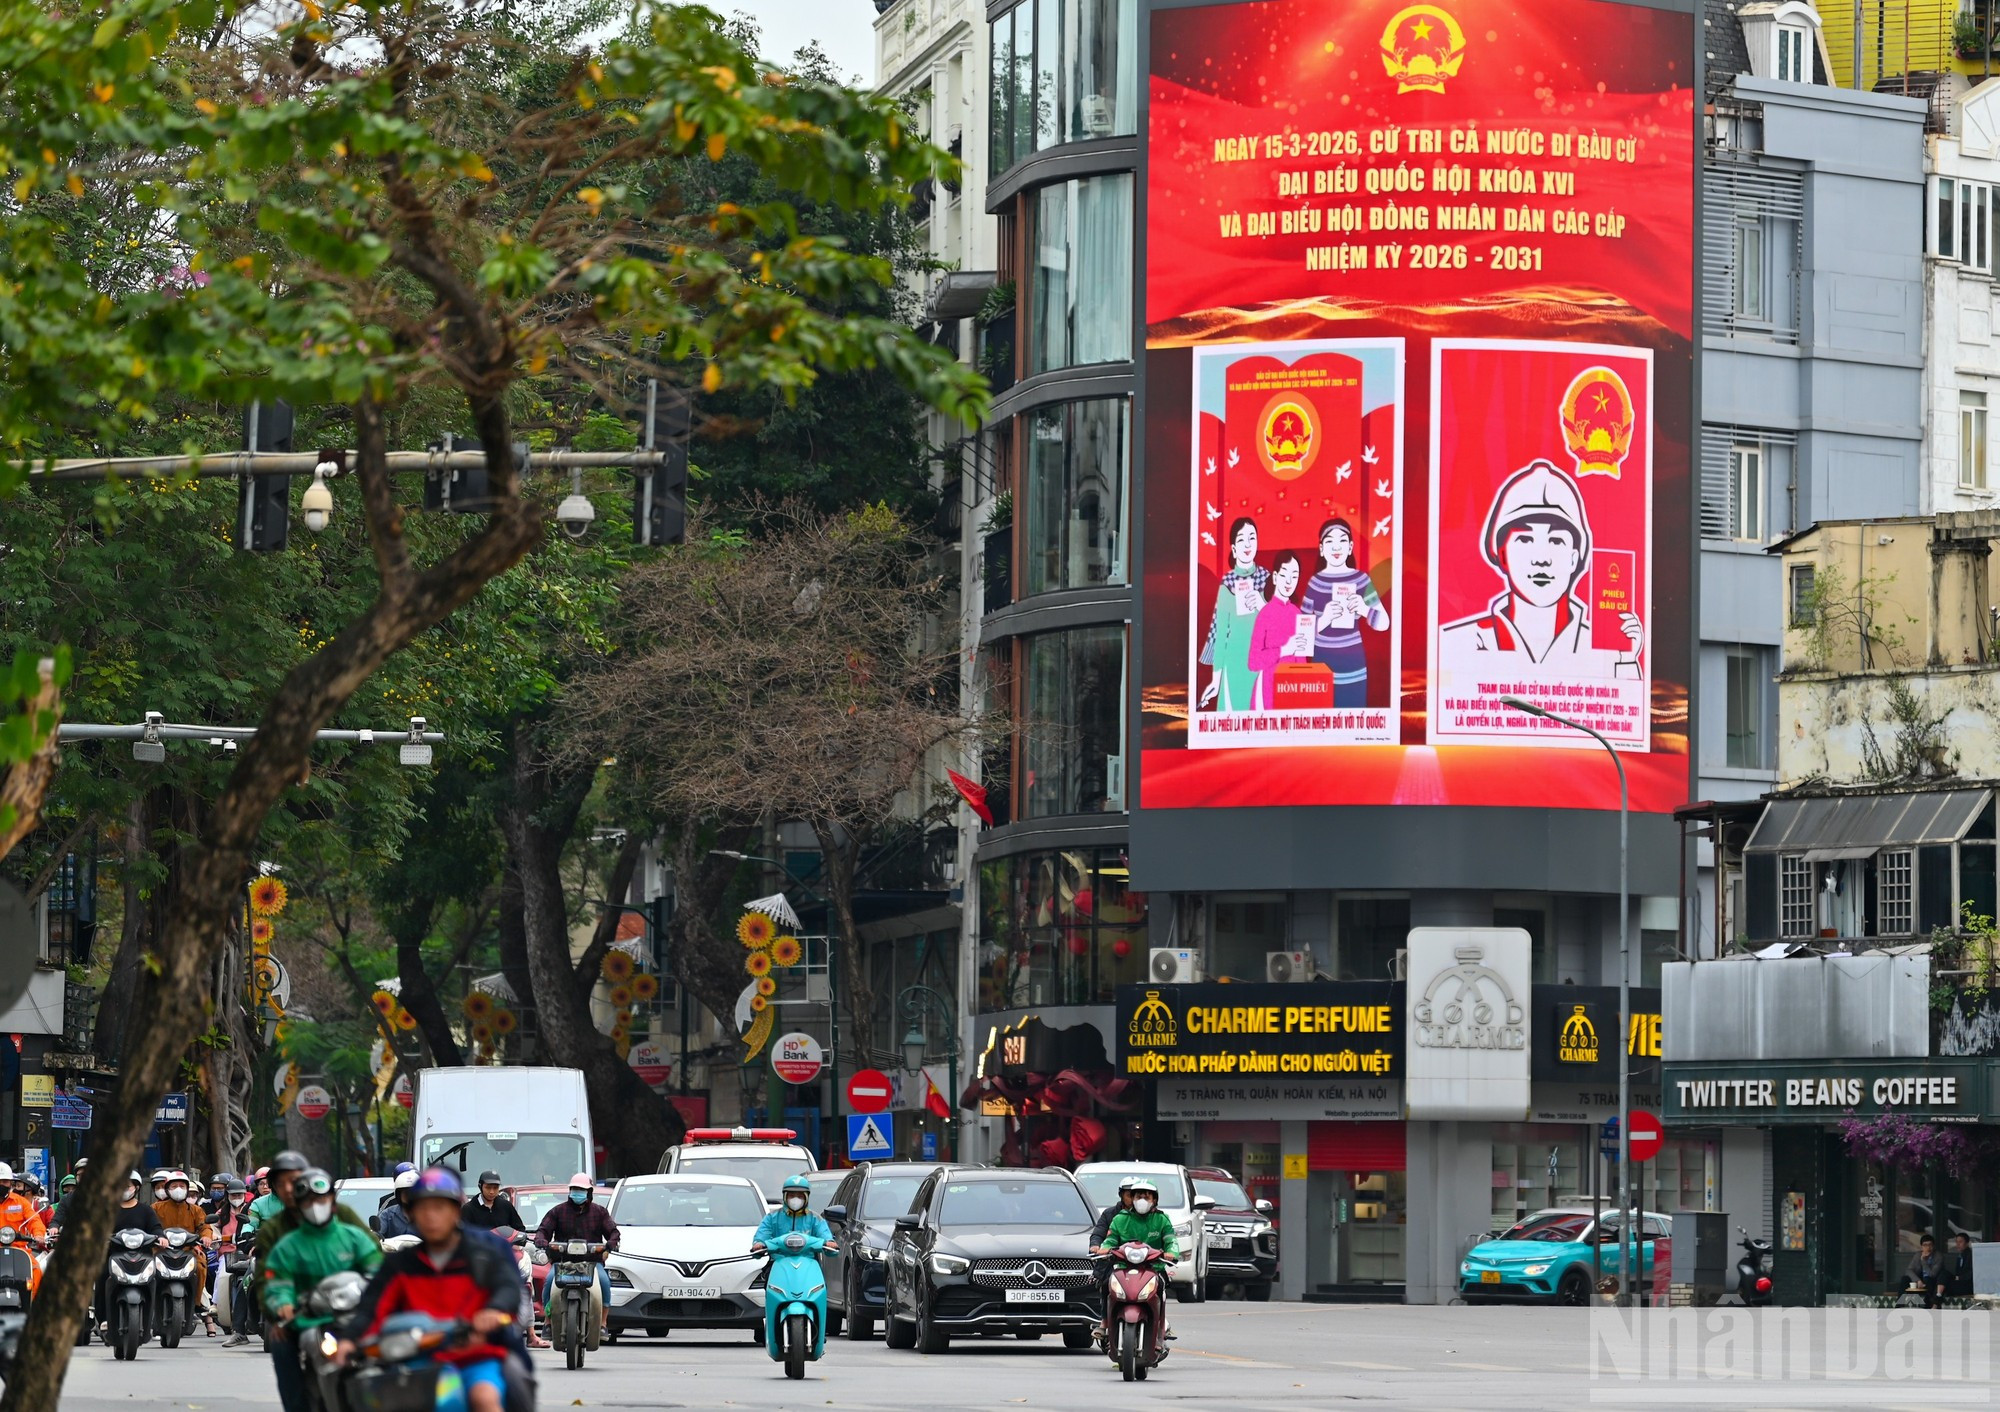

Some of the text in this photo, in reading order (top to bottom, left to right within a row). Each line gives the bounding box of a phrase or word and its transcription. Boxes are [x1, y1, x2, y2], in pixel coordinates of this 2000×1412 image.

[1214, 124, 1637, 163] NGÀY 15-3-2026, CỬ TRI CẢ NƯỚC ĐI BẦU CỬ
[1279, 160, 1574, 199] ĐẠI BIỂU QUỐC HỘI KHÓA XVI
[1220, 199, 1626, 239] VÀ ĐẠI BIỂU HỘI ĐỒNG NHÂN DÂN CÁC CẤP
[1306, 242, 1367, 274] NHIỆM
[1375, 242, 1402, 268] KỲ
[1410, 244, 1467, 269] 2026
[1490, 246, 1542, 270] 2031
[1277, 680, 1328, 693] HÒM PHIẾU
[1478, 683, 1497, 694] THAM
[1500, 684, 1511, 694] GIA
[1456, 700, 1468, 712] ĐẠI
[1489, 699, 1500, 713] HỘI
[1187, 1006, 1392, 1034] CHARME PERFUME
[1129, 1033, 1177, 1046] CHARME
[1415, 1024, 1525, 1050] CHARME
[784, 1042, 798, 1050] HD
[784, 1051, 808, 1060] Bank
[1127, 1049, 1392, 1076] NƯỚC HOA PHÁP DÀNH CHO NGƯỜI VIỆT
[1560, 1048, 1598, 1062] CHARME
[1176, 1090, 1187, 1100] 75
[1190, 1087, 1226, 1100] TRÀNG
[1250, 1086, 1278, 1102] QUẬN
[1284, 1086, 1312, 1100] HOÀN
[1350, 1086, 1364, 1100] HÀ
[1369, 1086, 1387, 1102] NỘI
[1579, 1094, 1589, 1105] 75
[1677, 1077, 1956, 1107] TWITTER BEANS COFFEE
[1011, 1292, 1060, 1301] 30F-855.66
